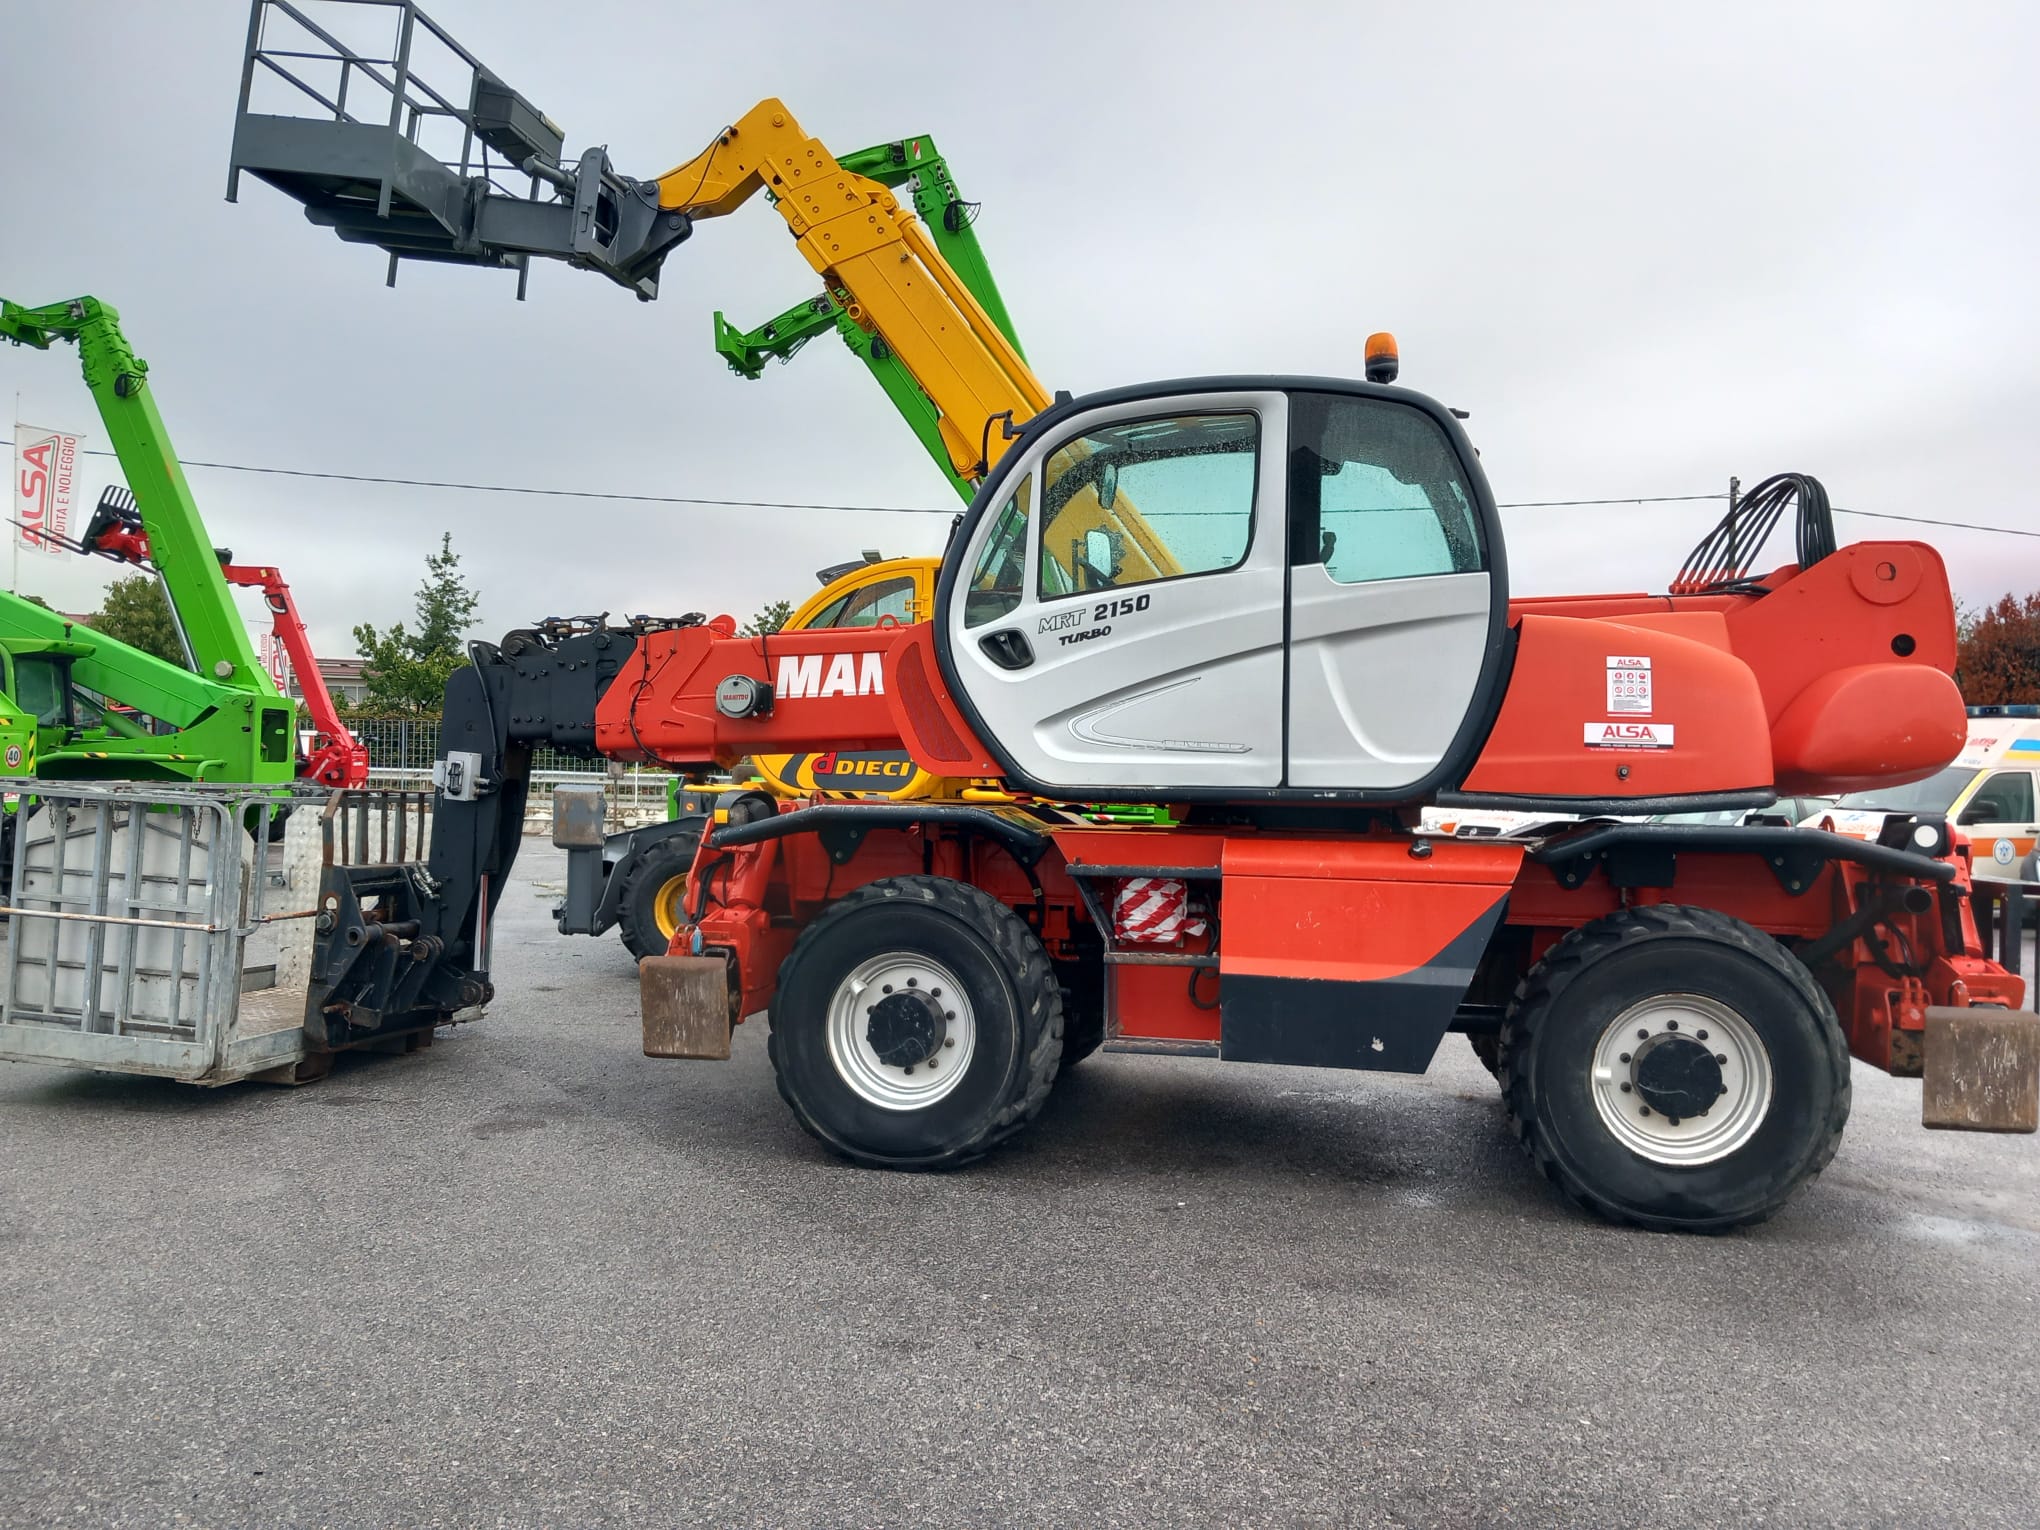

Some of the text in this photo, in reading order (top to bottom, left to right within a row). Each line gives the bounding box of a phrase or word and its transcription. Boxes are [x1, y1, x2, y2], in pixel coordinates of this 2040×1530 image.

[58, 437, 76, 493] NOLEGGIO
[21, 444, 51, 547] ALSA
[1038, 594, 1150, 634] MRT 2150
[1058, 625, 1112, 646] TURBO
[1602, 725, 1652, 739] ALSA
[8, 750, 19, 762] 40
[835, 760, 911, 776] DIECI
